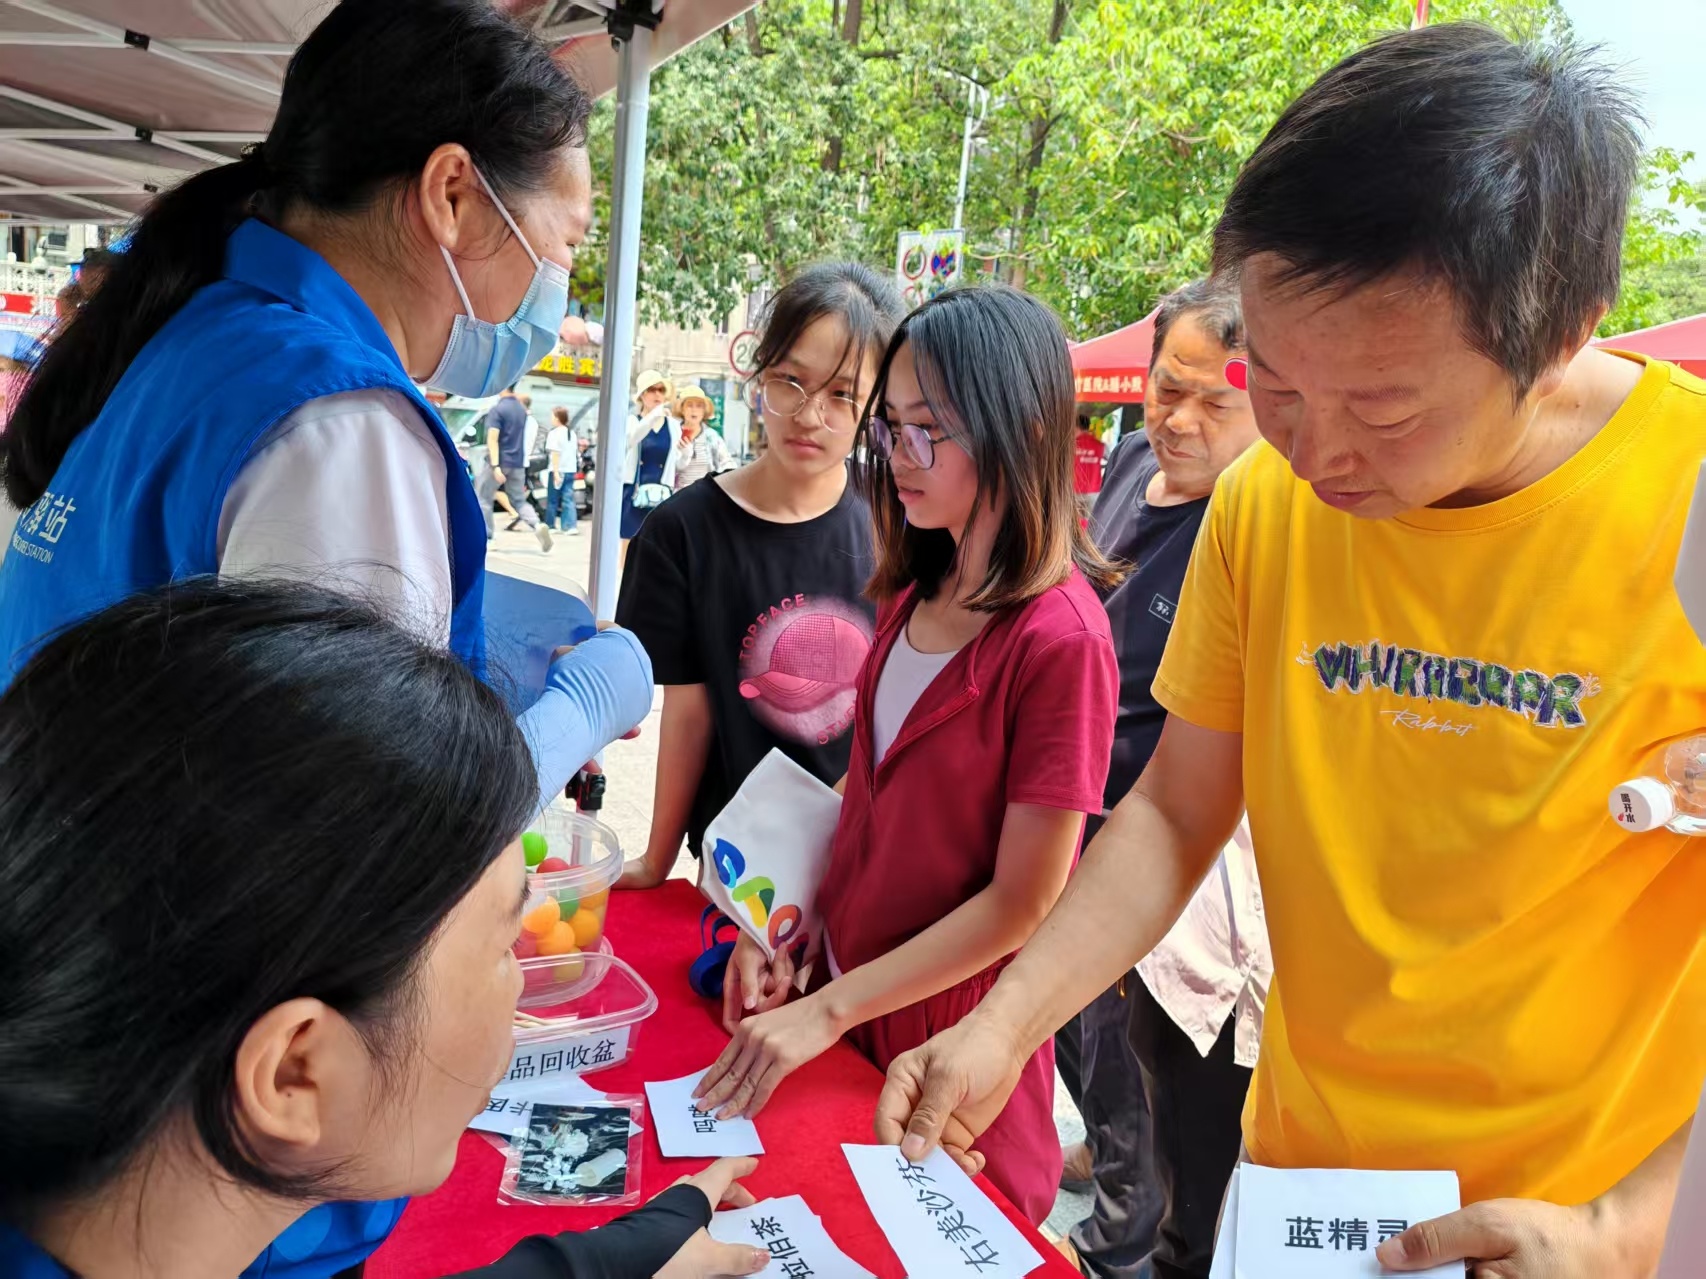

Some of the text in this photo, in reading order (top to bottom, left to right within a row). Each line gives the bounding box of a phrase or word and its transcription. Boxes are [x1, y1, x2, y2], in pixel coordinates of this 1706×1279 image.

[739, 593, 806, 661] TOPFACE
[1381, 708, 1478, 737] Rabbit
[502, 1038, 616, 1081] 品回收盆
[896, 1158, 1000, 1274] 右美沙芬
